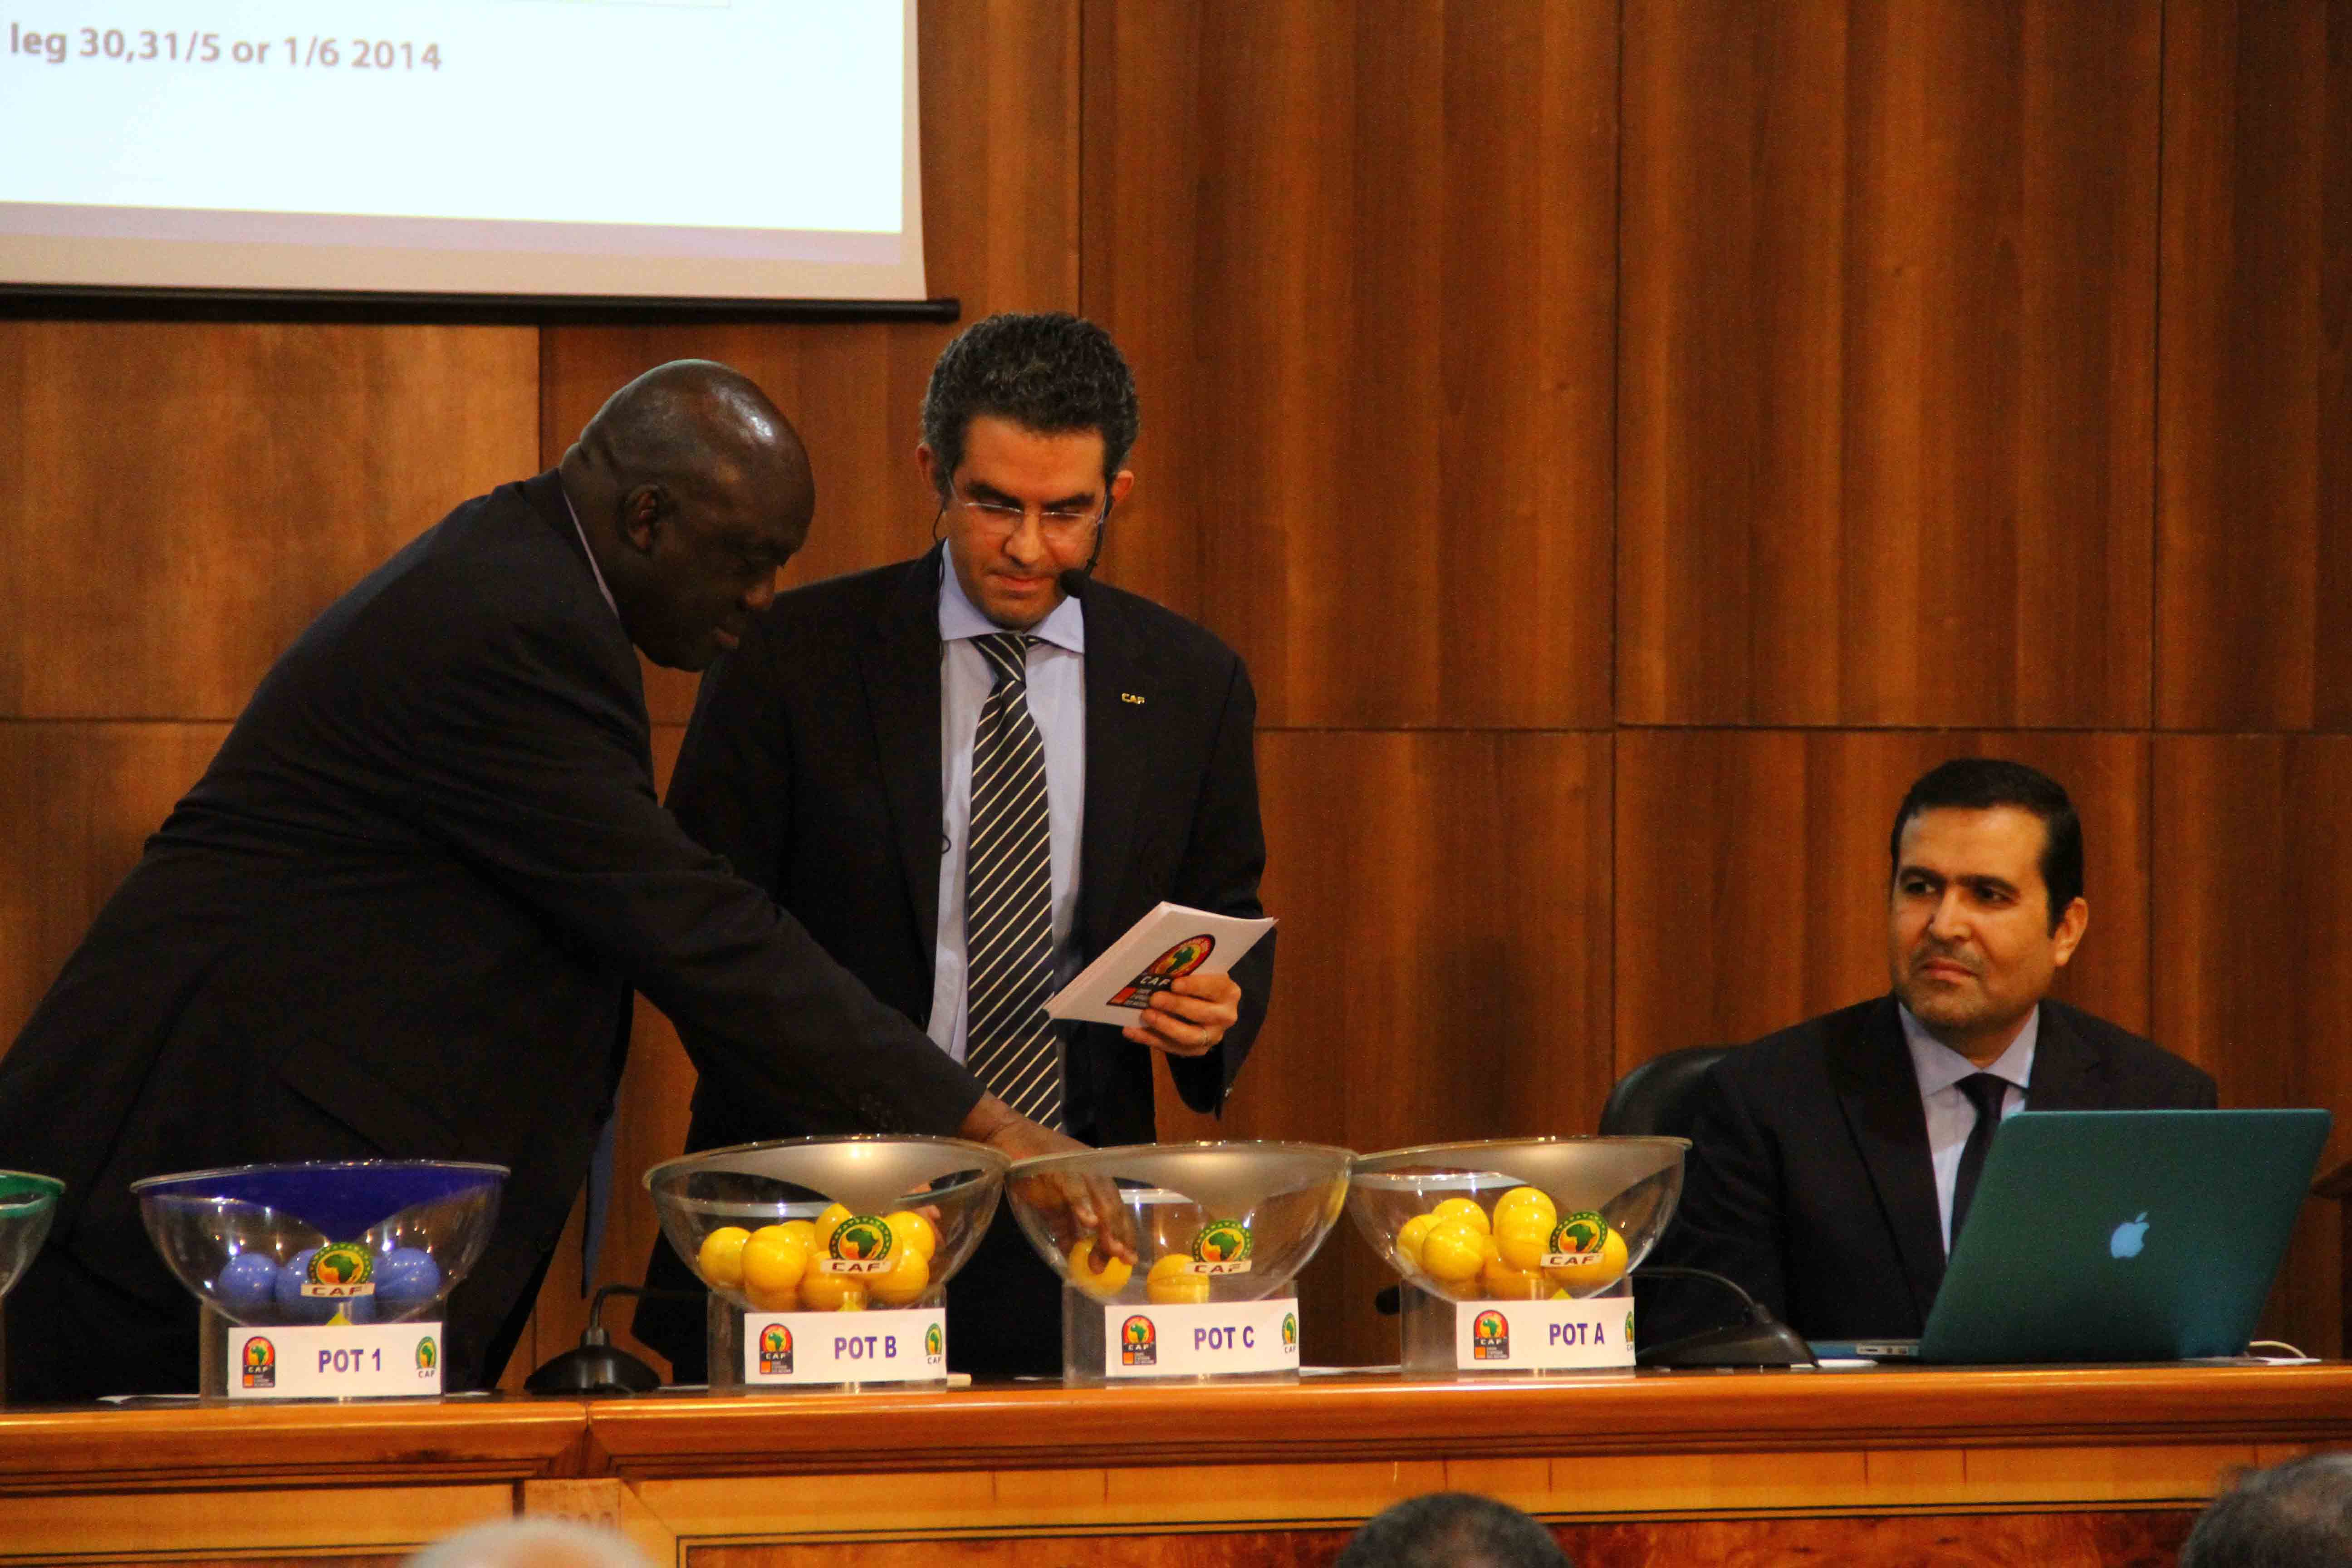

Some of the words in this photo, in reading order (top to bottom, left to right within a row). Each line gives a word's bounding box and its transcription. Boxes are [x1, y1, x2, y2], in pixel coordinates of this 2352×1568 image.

[10, 22, 67, 64] leg
[79, 26, 220, 63] 30,31/5
[231, 39, 270, 64] or
[284, 34, 339, 67] 1/6
[351, 38, 442, 71] 2014
[832, 1262, 880, 1272] CAF
[1194, 1262, 1241, 1274] CAF
[1549, 1256, 1595, 1266] CAF
[312, 1286, 363, 1297] CAF
[1194, 1327, 1236, 1350] POT
[1243, 1325, 1254, 1348] C
[1549, 1323, 1588, 1346] POT
[1594, 1322, 1605, 1345] A
[834, 1336, 877, 1359] POT
[885, 1336, 897, 1358] B
[318, 1348, 364, 1373] POT
[372, 1348, 381, 1371] 1
[418, 1370, 436, 1379] CAF
